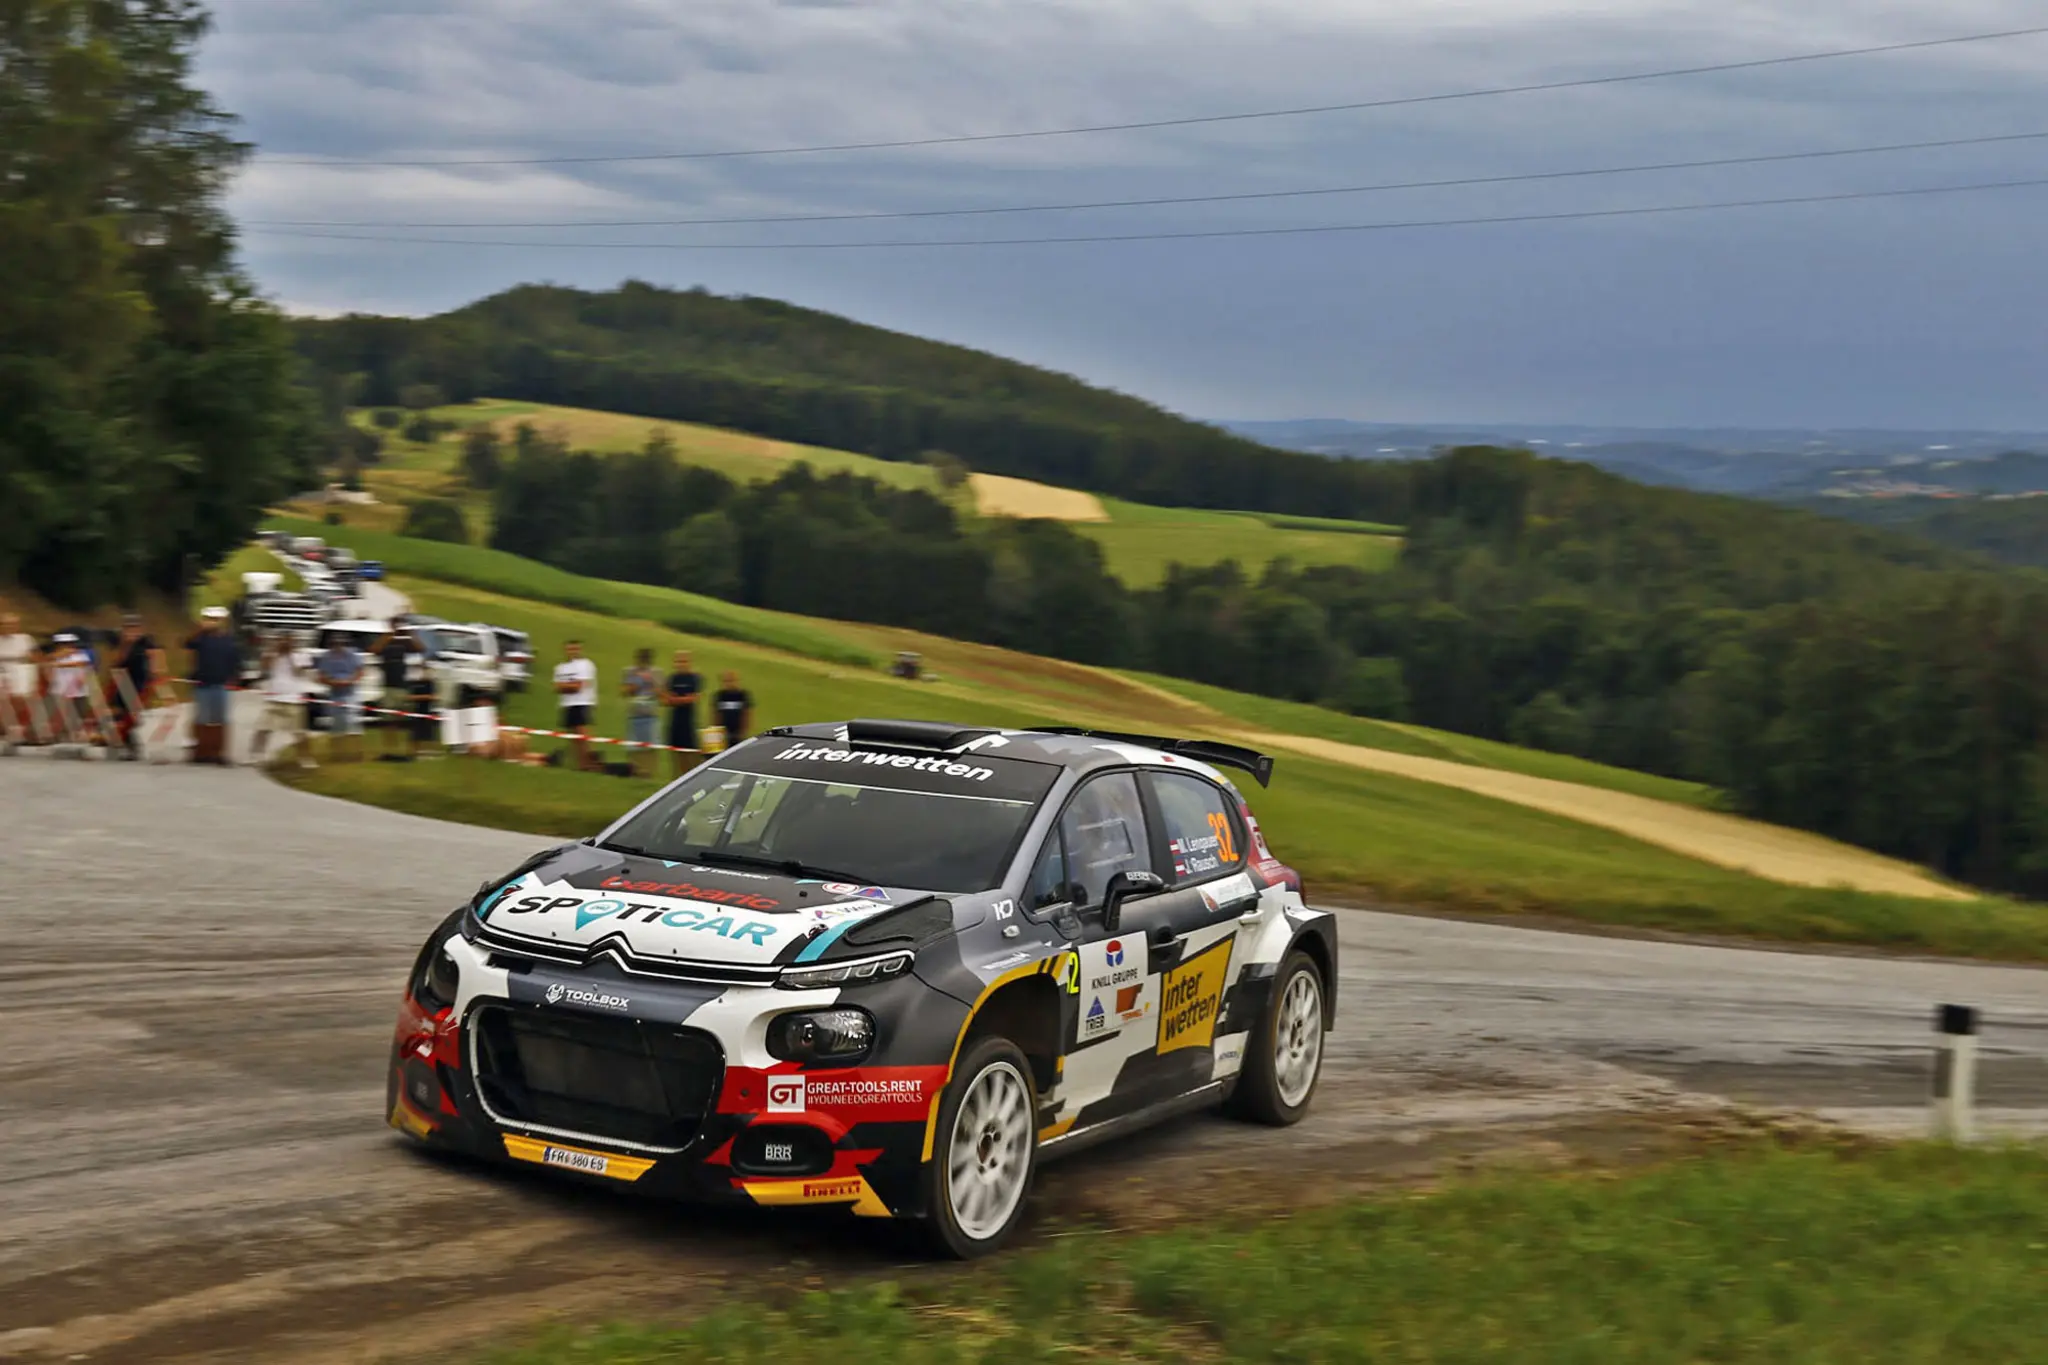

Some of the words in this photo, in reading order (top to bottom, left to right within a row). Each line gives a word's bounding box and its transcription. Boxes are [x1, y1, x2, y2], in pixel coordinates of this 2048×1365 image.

[773, 742, 994, 781] interwetten
[1207, 812, 1239, 862] 32
[600, 875, 780, 909] barbaric
[1091, 976, 1112, 991] KNILL
[1112, 967, 1139, 986] GRUPPE
[565, 989, 630, 1008] TOOLBOX
[1165, 970, 1203, 1013] inter
[1085, 1015, 1105, 1032] TRIEB
[1165, 993, 1217, 1041] wetten
[769, 1083, 803, 1105] GT
[807, 1080, 922, 1095] GREAT-TOOLS.RENT
[551, 1150, 565, 1163] FR
[765, 1144, 792, 1161] BRR
